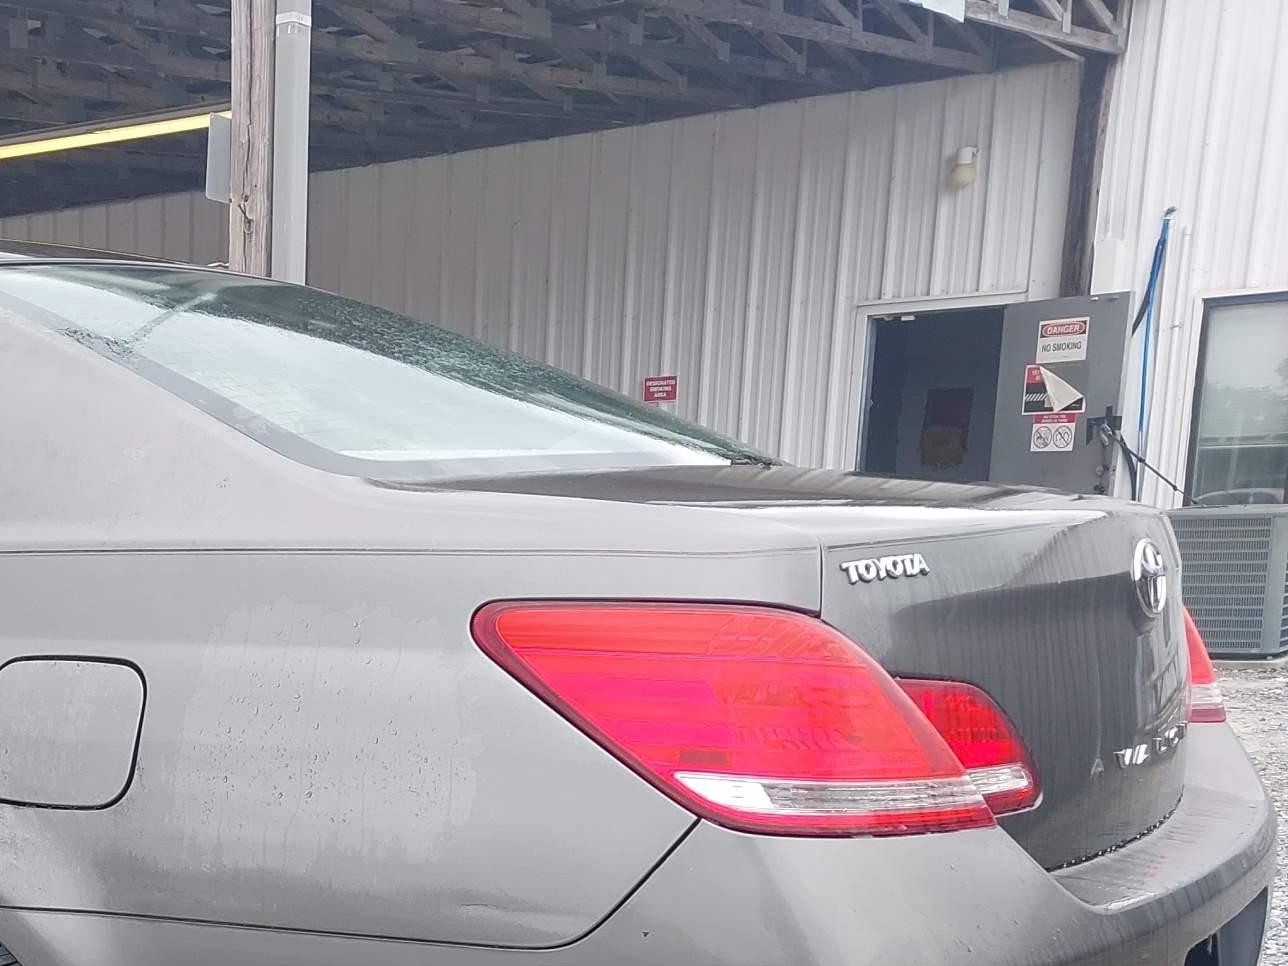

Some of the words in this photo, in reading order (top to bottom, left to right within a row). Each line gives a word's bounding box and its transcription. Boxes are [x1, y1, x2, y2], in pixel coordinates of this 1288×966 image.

[1047, 324, 1080, 335] DANGER
[1041, 344, 1052, 353] NO
[1052, 341, 1082, 352] SMOKING
[840, 553, 930, 584] TOYOTA
